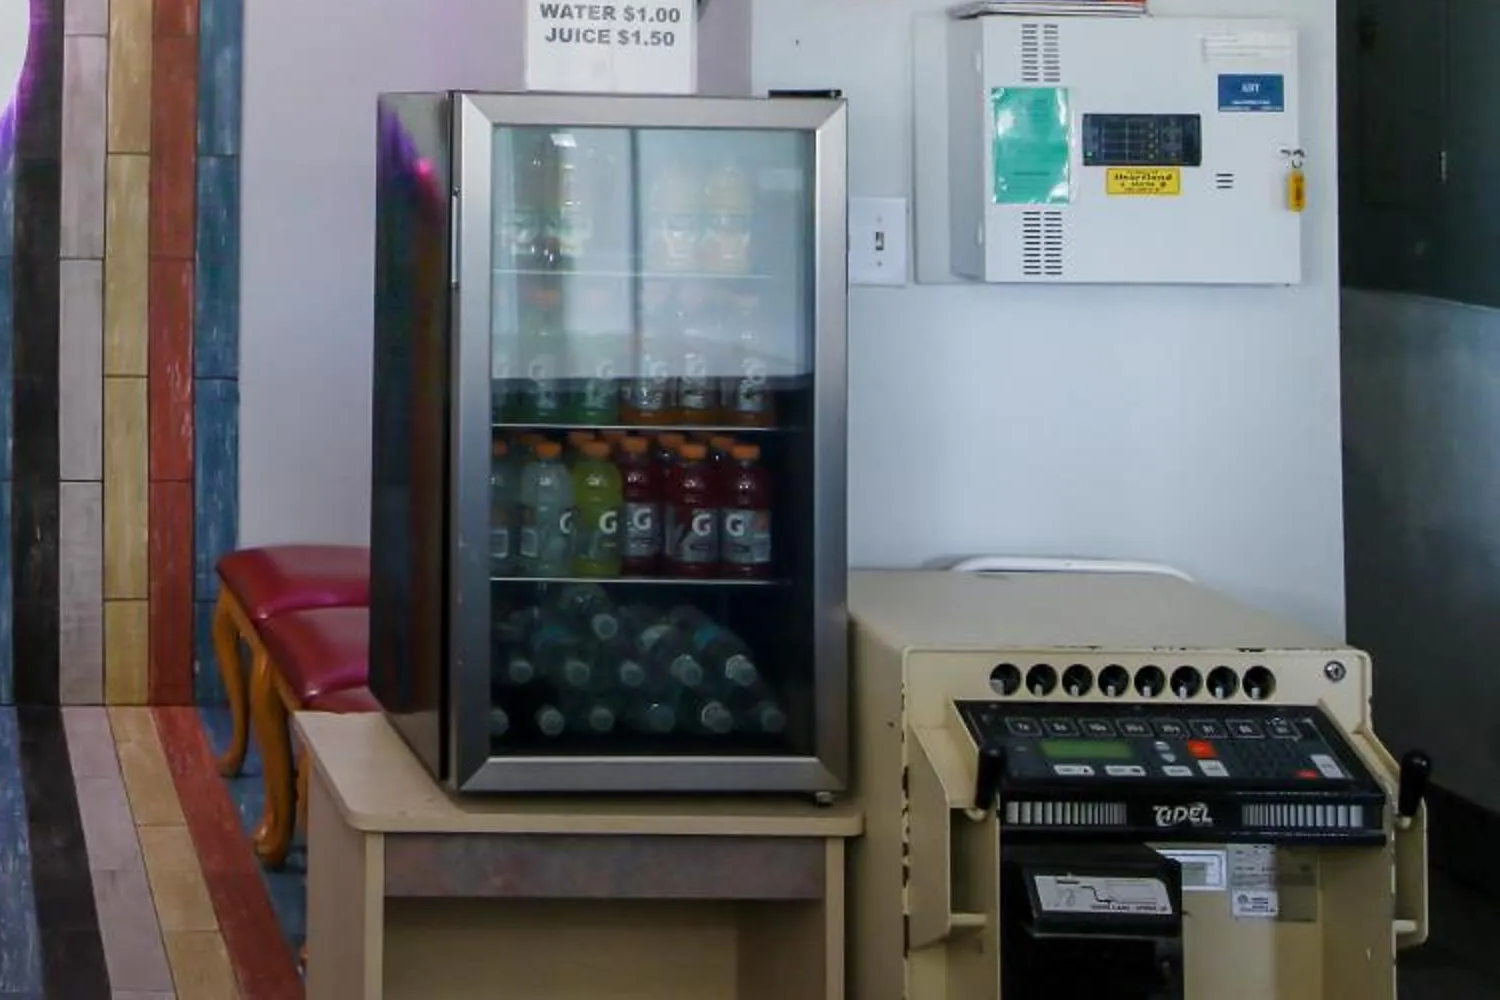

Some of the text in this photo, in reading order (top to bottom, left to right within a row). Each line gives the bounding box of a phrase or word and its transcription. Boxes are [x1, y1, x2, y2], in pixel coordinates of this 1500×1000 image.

[540, 4, 681, 23] WATER $1.00
[545, 28, 675, 47] JUICE $1.50
[599, 511, 617, 534] G
[633, 508, 652, 530] G
[692, 513, 712, 536] G
[726, 514, 745, 537] G
